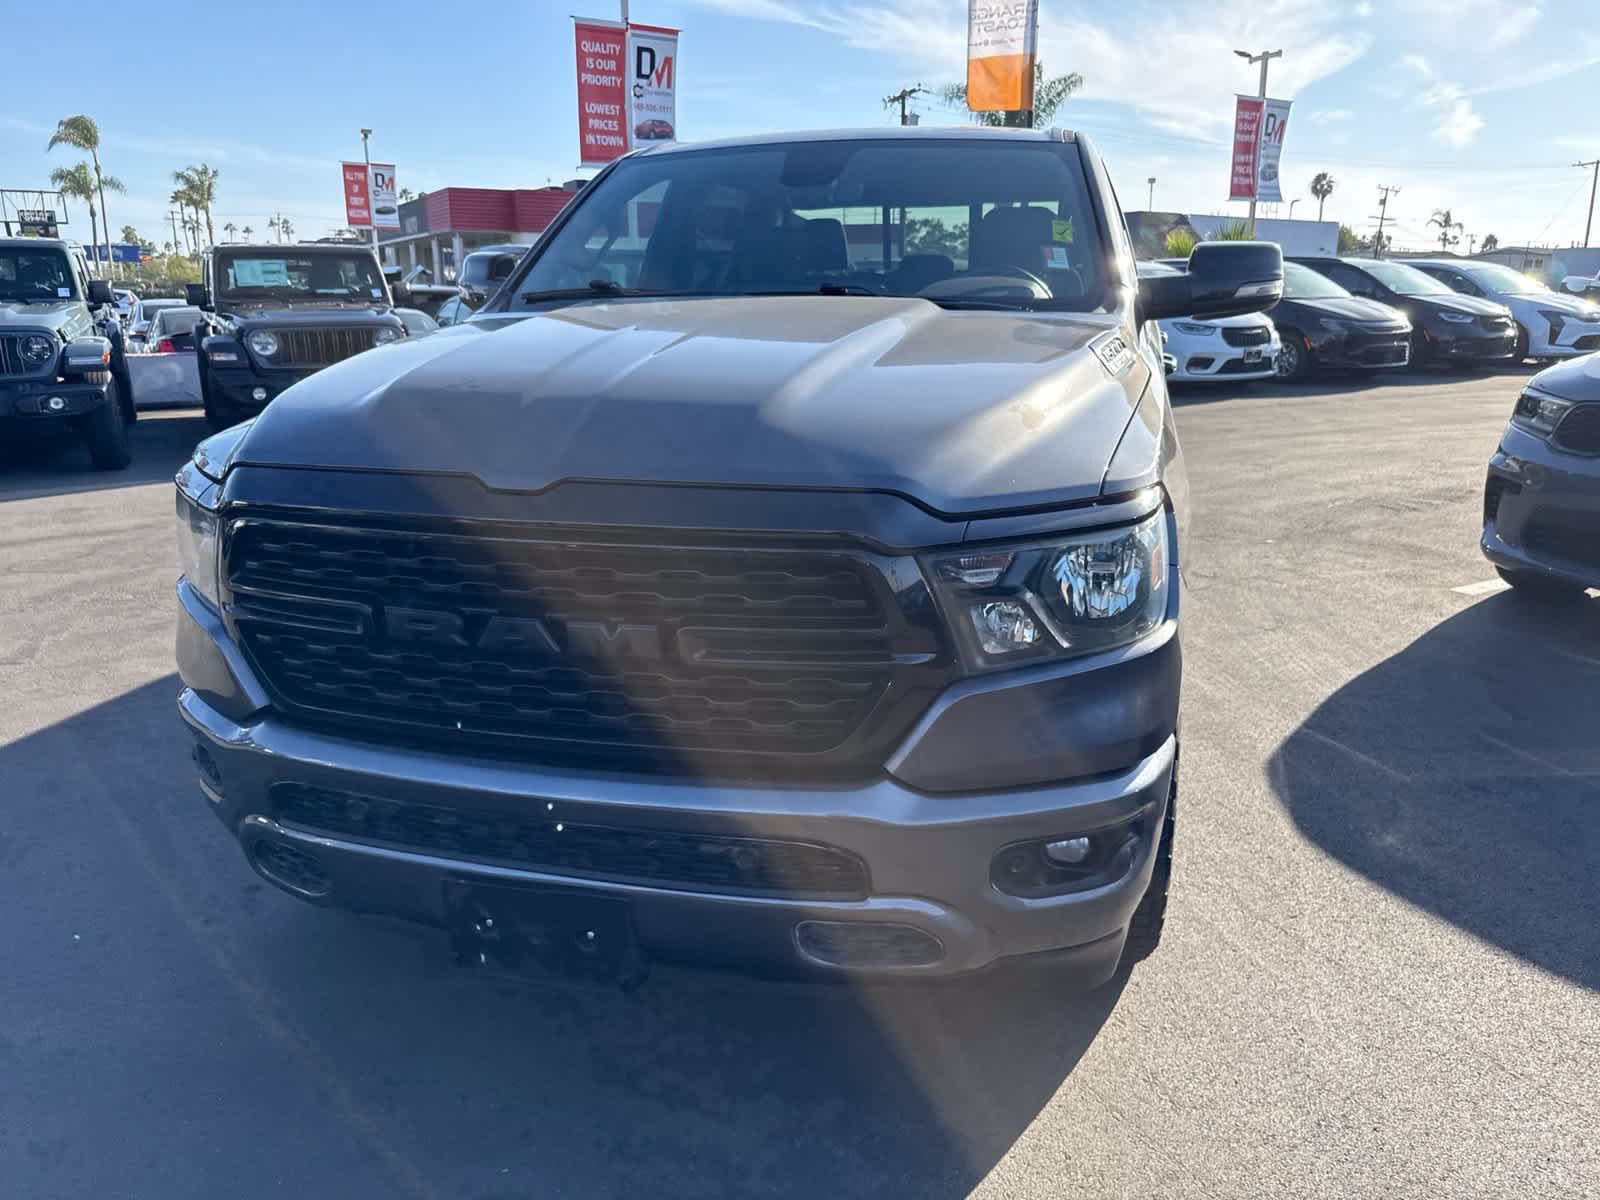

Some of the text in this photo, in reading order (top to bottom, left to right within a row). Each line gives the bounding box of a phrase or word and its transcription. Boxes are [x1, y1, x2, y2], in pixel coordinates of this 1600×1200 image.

[581, 40, 621, 55] QUALITY
[586, 58, 617, 71] IS OUR
[581, 73, 622, 89] PRIORITY
[585, 102, 621, 116] LOWEST
[588, 118, 619, 131] PRICES
[585, 134, 624, 147] IN TOWN
[384, 605, 660, 658] RAM
